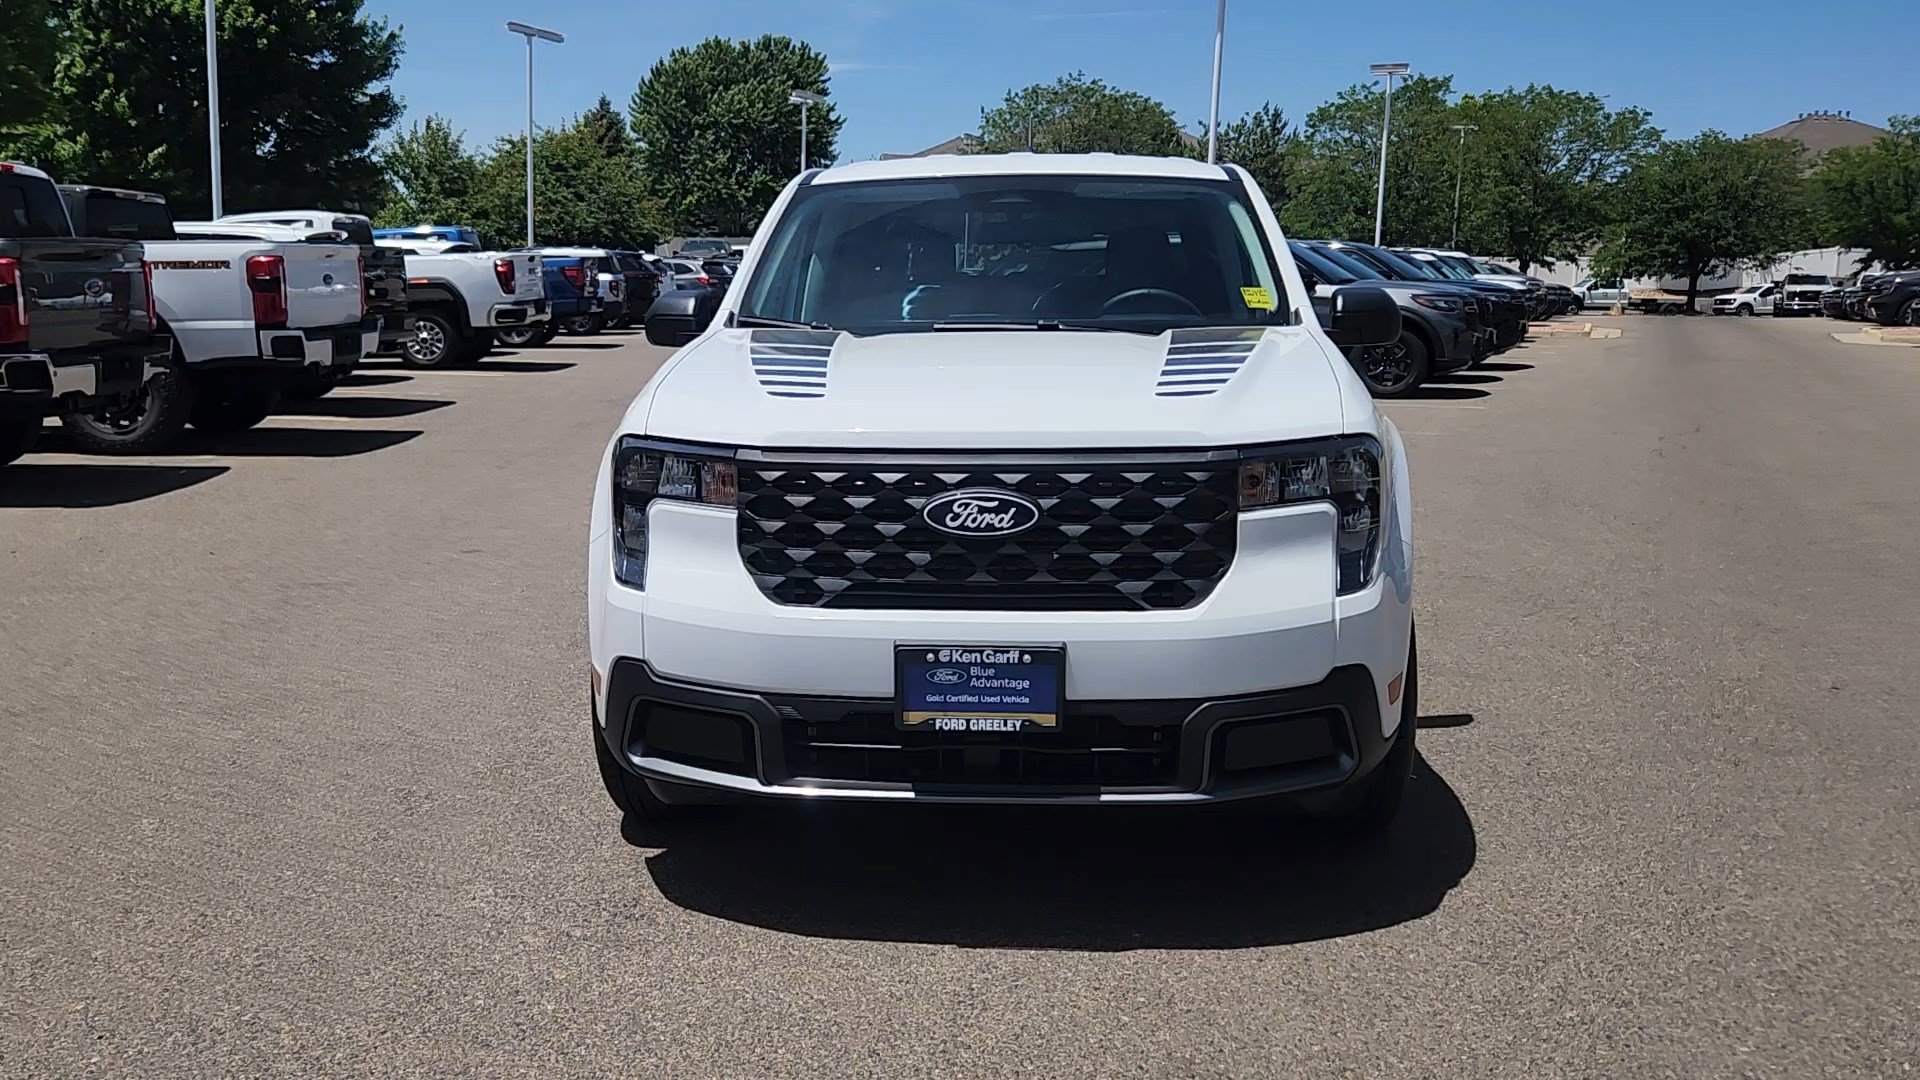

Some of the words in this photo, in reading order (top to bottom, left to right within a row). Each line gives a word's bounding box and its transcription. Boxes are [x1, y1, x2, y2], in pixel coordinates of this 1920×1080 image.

[151, 260, 231, 269] TREMOR
[945, 499, 1017, 528] Ford
[952, 650, 981, 663] Ken
[982, 650, 1020, 664] Garff
[933, 671, 959, 681] Ford
[970, 666, 995, 676] Blue
[970, 678, 1030, 689] Advantage
[926, 694, 944, 702] Gold
[946, 694, 978, 703] Certified
[980, 695, 1000, 703] Used
[1002, 695, 1030, 703] Vehicle
[935, 719, 966, 731] FORD
[969, 719, 1022, 731] GREELEY
